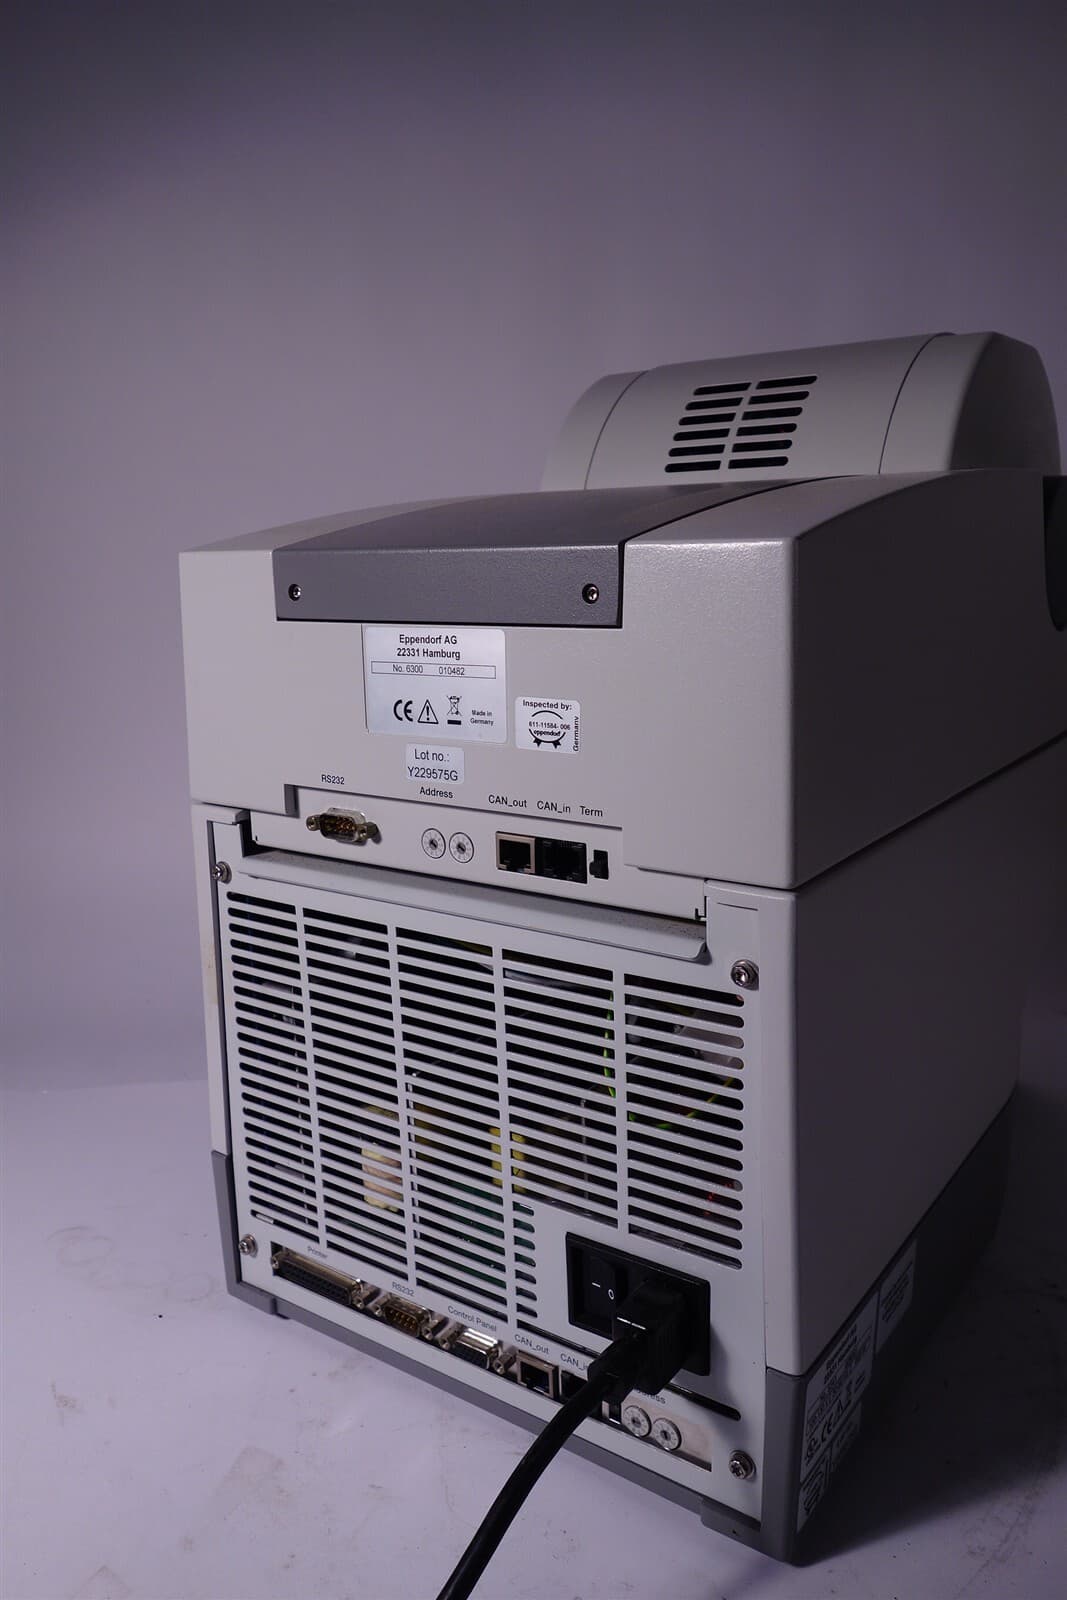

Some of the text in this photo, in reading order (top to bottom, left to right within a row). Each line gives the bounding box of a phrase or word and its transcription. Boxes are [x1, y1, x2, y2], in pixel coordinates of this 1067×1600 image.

[399, 634, 458, 646] Eppendorf AG
[396, 647, 460, 660] 22331 Hamburg
[392, 664, 403, 673] No.
[405, 665, 424, 674] 6300
[522, 699, 572, 711] Inspected by:
[471, 709, 486, 717] Made
[470, 717, 494, 727] Germany
[414, 748, 450, 762] Lot no.:
[321, 774, 345, 786] RS232
[407, 766, 458, 782] Y229575G
[419, 786, 453, 799] Address
[488, 794, 527, 809] CAN_out
[537, 801, 571, 814] CAN_in
[580, 805, 603, 818] Term
[307, 1246, 327, 1259] Printer
[391, 1281, 414, 1298] RS232
[447, 1305, 497, 1332] Control Panel
[514, 1334, 549, 1354] CAN_out
